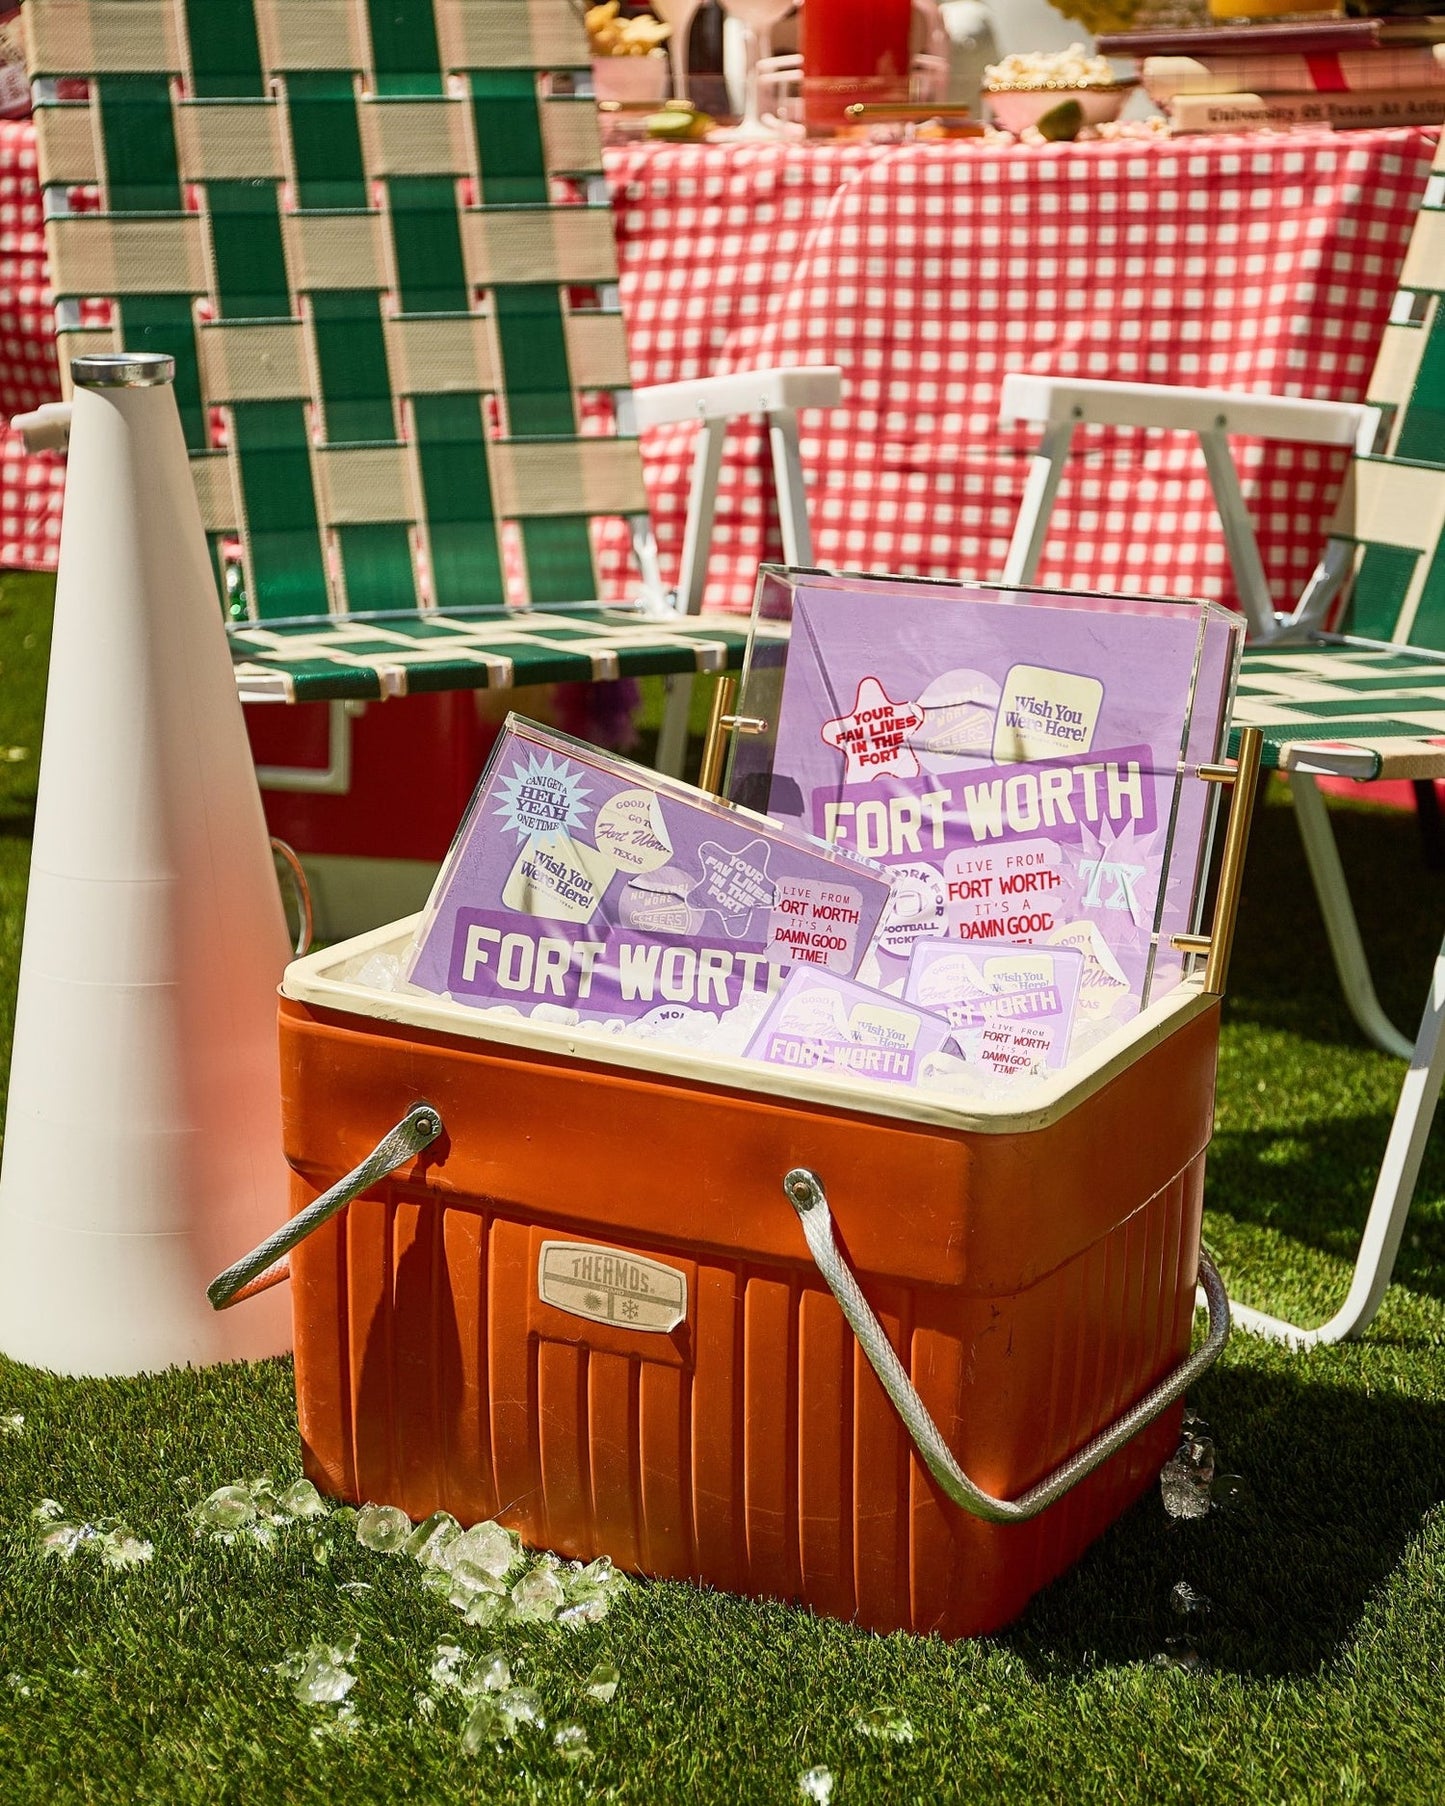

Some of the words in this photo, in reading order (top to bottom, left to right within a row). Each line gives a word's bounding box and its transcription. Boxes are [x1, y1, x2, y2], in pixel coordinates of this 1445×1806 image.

[853, 706, 894, 725] YOUR
[1055, 704, 1083, 724] You
[836, 727, 864, 744] FAV
[869, 715, 917, 736] LIVES
[1045, 720, 1087, 742] Here!
[851, 740, 867, 754] IN
[871, 732, 904, 749] THE
[858, 746, 900, 766] FORT
[519, 785, 570, 808] HELL
[616, 800, 645, 809] GOOD
[516, 797, 568, 822] YEAH
[628, 814, 642, 824] GO
[823, 789, 952, 858] FORT
[964, 761, 1144, 842] WORTH
[517, 813, 535, 829] ONE
[535, 818, 560, 831] TIME
[595, 822, 629, 841] Fort
[613, 847, 644, 864] TEXAS
[957, 859, 993, 874] LIVE
[1007, 853, 1045, 868] FROM
[533, 850, 567, 880] Wish
[567, 869, 593, 893] You
[704, 855, 733, 877] FAV
[732, 872, 773, 904] LIVES
[728, 855, 764, 885] YOUR
[554, 879, 594, 909] Here!
[709, 871, 727, 888] IN
[727, 882, 756, 907] THE
[783, 886, 811, 898] LIVE
[820, 892, 850, 904] FROM
[948, 878, 993, 901] FORT
[999, 871, 1062, 895] WORTH
[1078, 859, 1147, 911] TX
[707, 885, 745, 913] FORT
[975, 901, 1009, 916] IT'S
[1022, 899, 1031, 910] A
[638, 914, 682, 926] CHEERS
[812, 904, 859, 925] WORTH
[790, 918, 817, 931] IT'S
[826, 924, 832, 933] A
[960, 919, 1004, 940] DAMN
[1007, 913, 1054, 935] GOOD
[775, 927, 810, 946] DAMN
[811, 934, 847, 951] GOOD
[462, 924, 606, 998] FORT
[790, 946, 828, 965] TIME!
[1023, 972, 1043, 981] You
[981, 990, 1057, 1020] WORTH
[886, 1027, 906, 1041] You
[983, 1031, 1011, 1043] FORT
[1013, 1036, 1050, 1050] WORTH
[992, 1023, 1013, 1032] LIVE
[1021, 1028, 1045, 1037] FROM
[770, 1038, 830, 1066] FORT
[834, 1045, 910, 1076] WORTH
[981, 1050, 1010, 1063] DAMN
[1010, 1055, 1031, 1067] GOO
[572, 1256, 649, 1293] THERMOS
